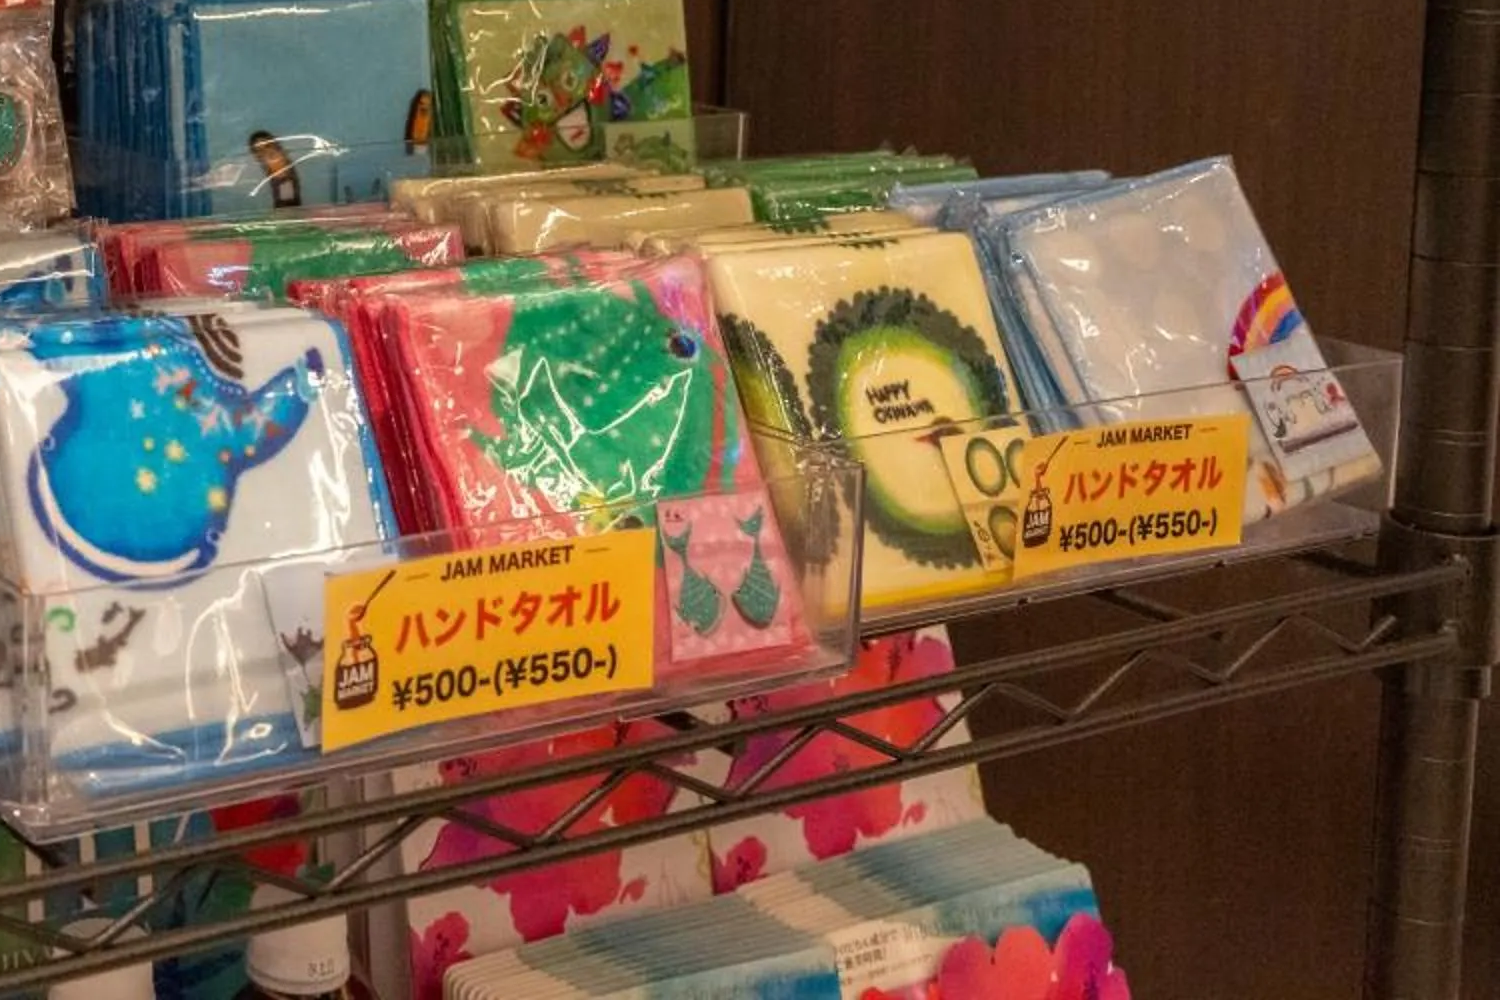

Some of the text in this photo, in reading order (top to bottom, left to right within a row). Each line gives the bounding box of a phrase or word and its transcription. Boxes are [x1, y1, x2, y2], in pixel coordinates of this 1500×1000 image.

[866, 379, 910, 406] HAPPY
[1096, 423, 1193, 449] JAM MARKET
[1063, 455, 1223, 505] ハンドタオル
[1027, 511, 1049, 529] JAM
[441, 545, 575, 581] JAM MARKET
[396, 580, 621, 654] ハンドタオル
[338, 661, 375, 688] JAM
